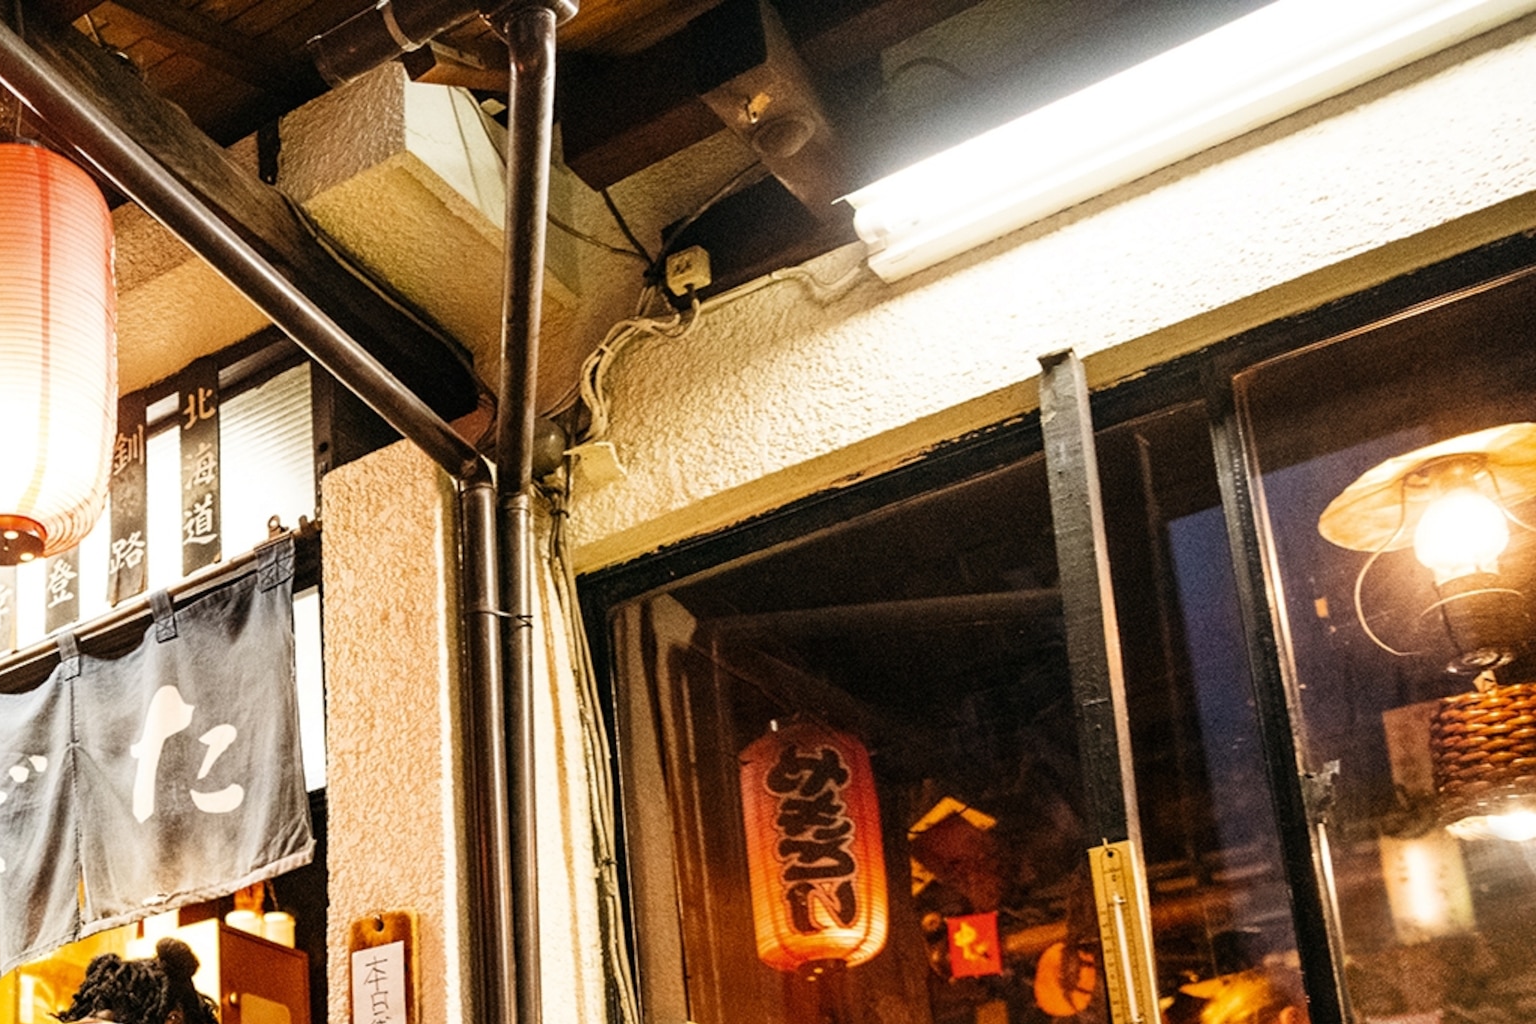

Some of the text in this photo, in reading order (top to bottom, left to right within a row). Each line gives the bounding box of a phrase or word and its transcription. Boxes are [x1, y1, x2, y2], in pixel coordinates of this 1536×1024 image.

[109, 424, 146, 575] 釧路
[183, 387, 218, 546] 北海道
